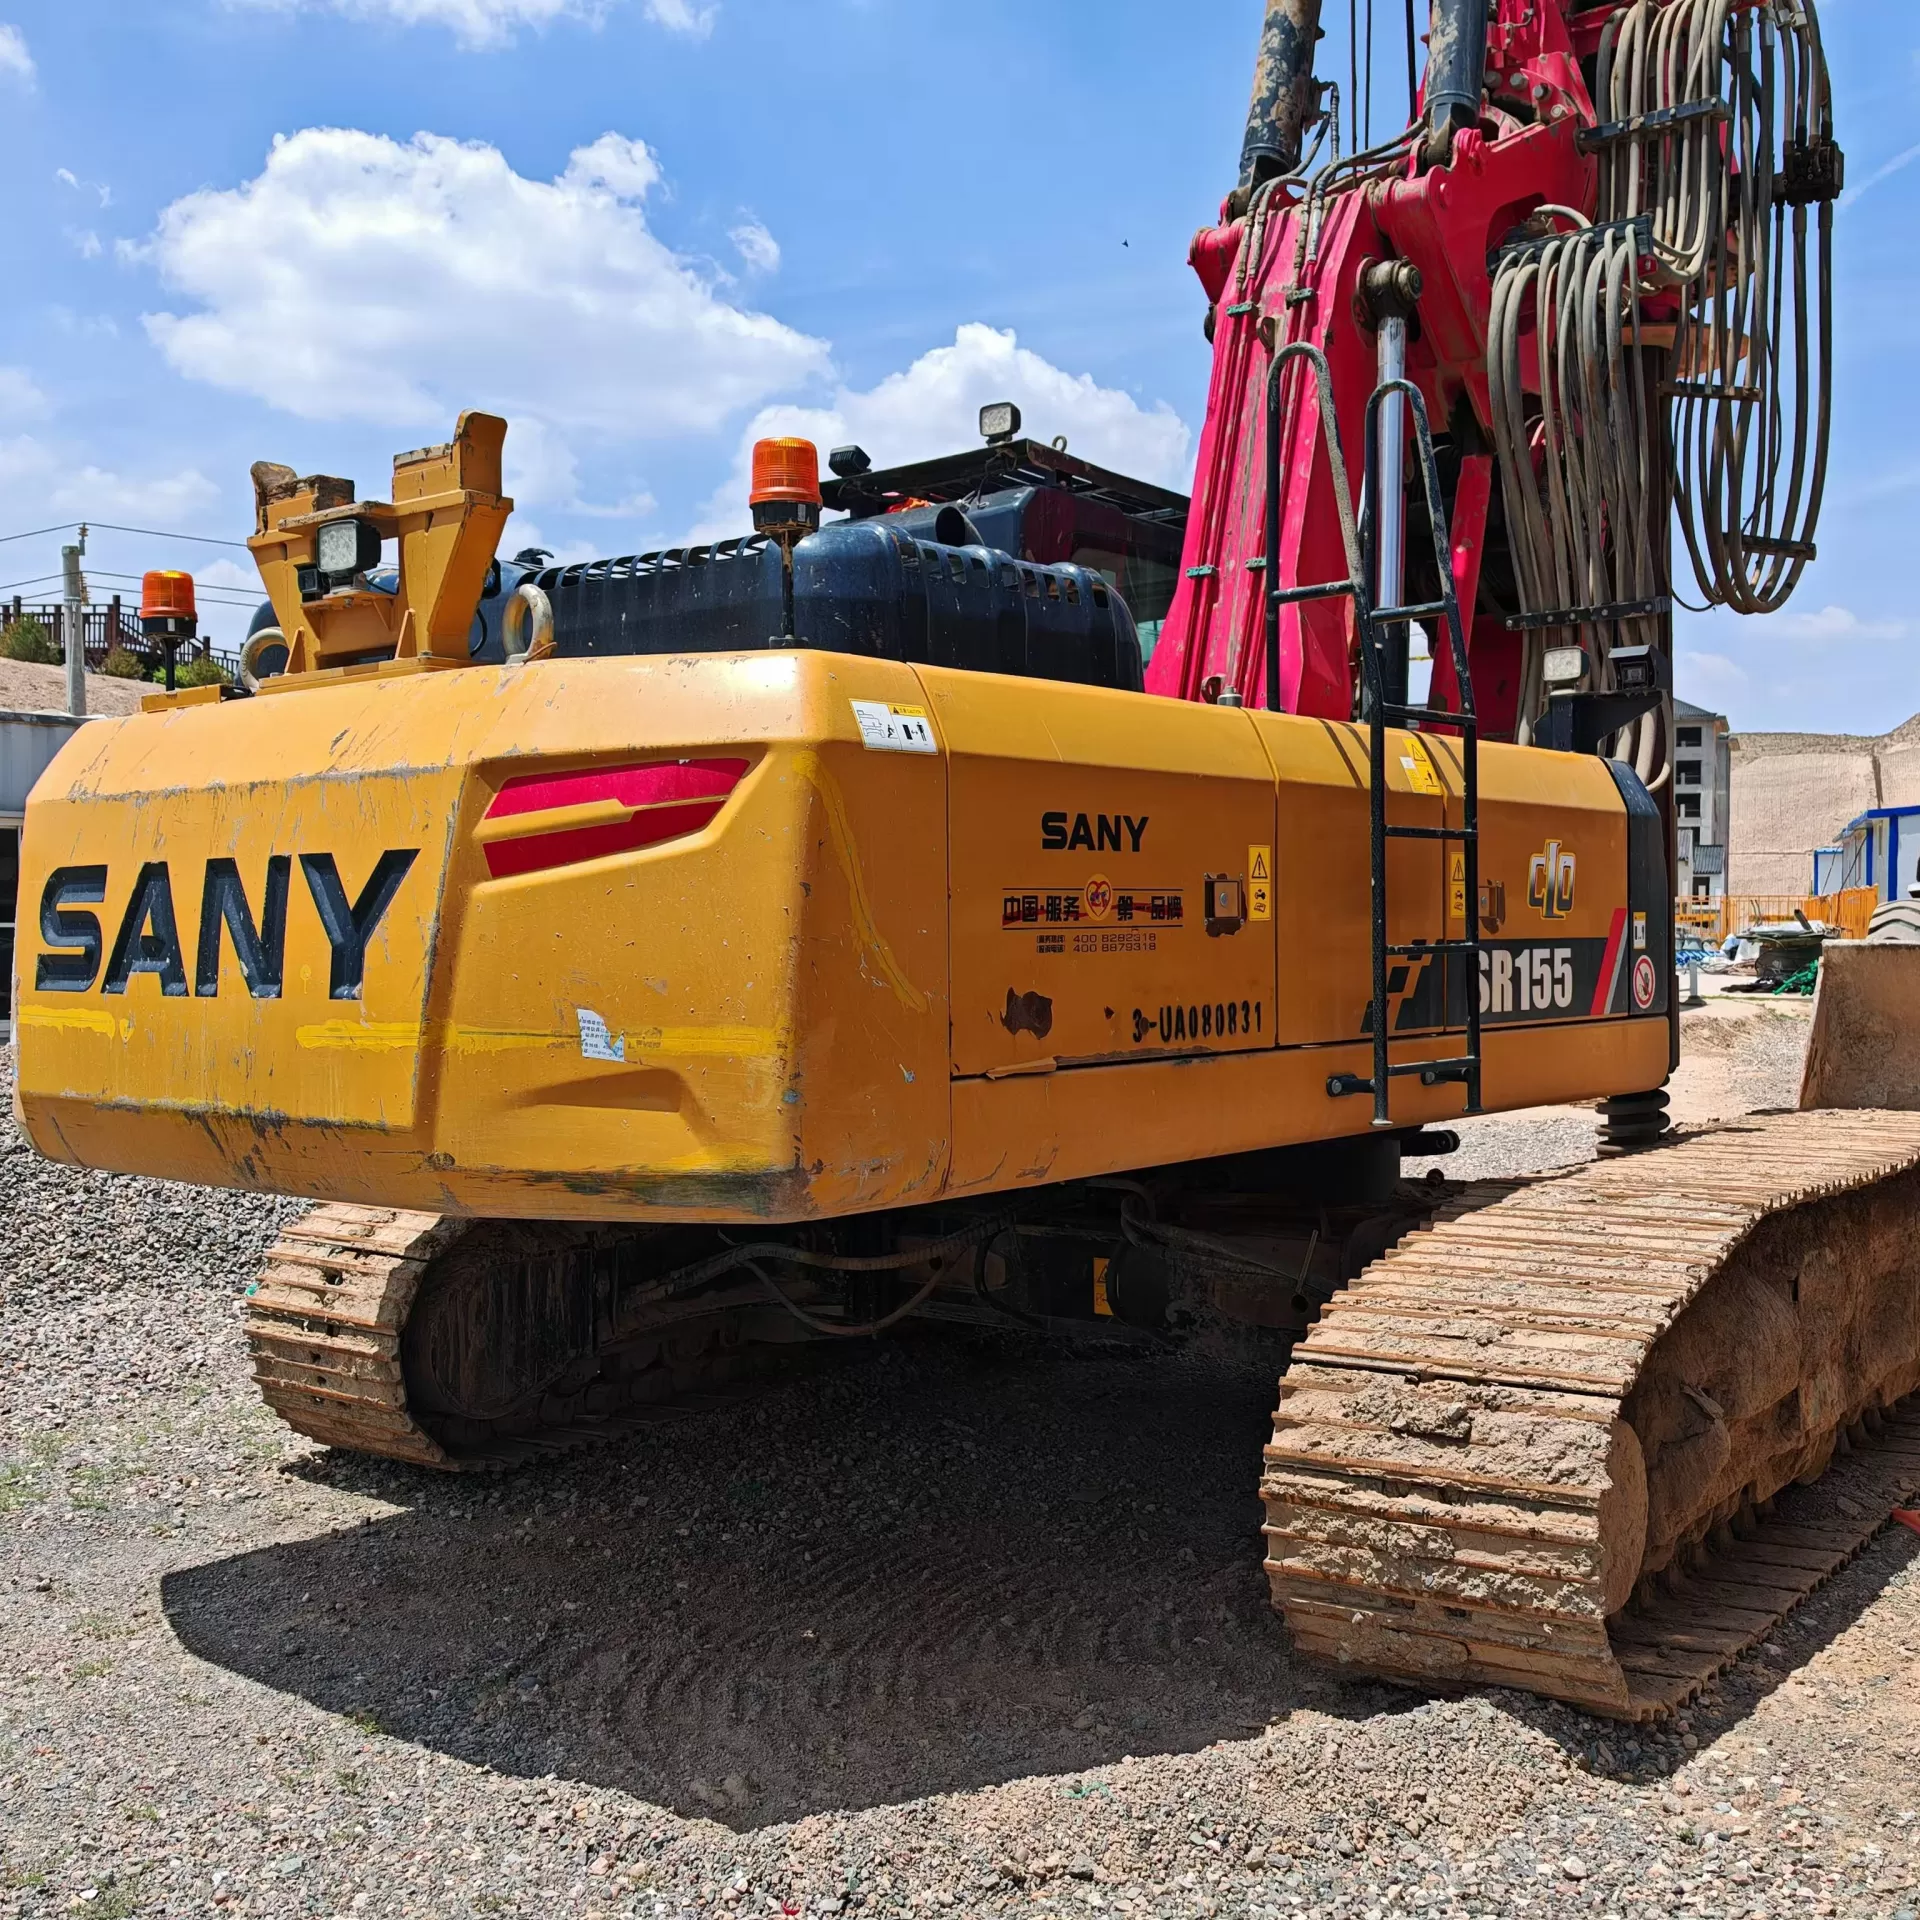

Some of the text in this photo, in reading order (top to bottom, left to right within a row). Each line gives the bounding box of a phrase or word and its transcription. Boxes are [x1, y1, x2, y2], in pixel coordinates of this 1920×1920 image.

[1041, 811, 1149, 852] SANY
[1117, 895, 1183, 921] 第一品牌
[35, 848, 421, 1000] SANY
[1073, 934, 1097, 943] 400
[1101, 933, 1157, 943] 8282318
[1073, 944, 1097, 952] 400
[1101, 943, 1157, 952] 8879318
